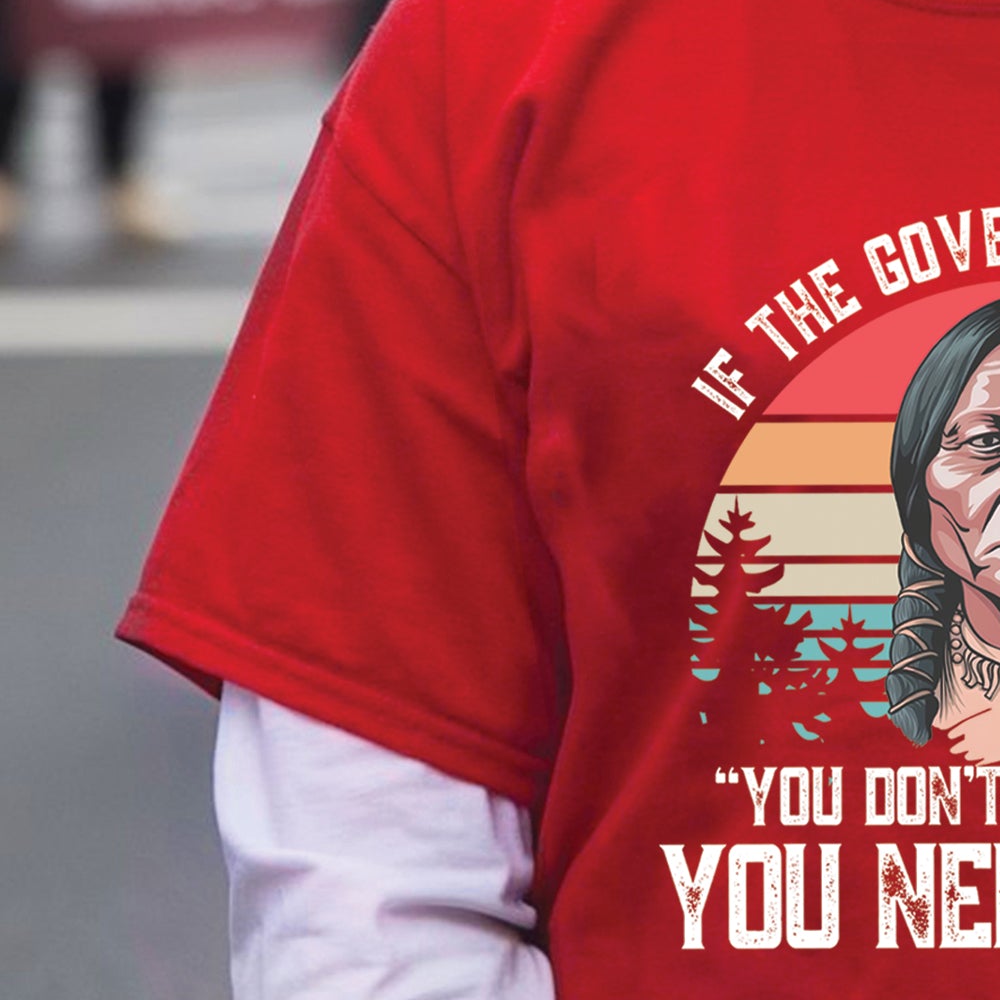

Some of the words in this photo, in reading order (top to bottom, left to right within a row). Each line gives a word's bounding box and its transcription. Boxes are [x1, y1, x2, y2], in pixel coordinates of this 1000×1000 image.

[692, 348, 755, 420] IF
[745, 259, 862, 360] THE
[660, 844, 841, 949] YOU
